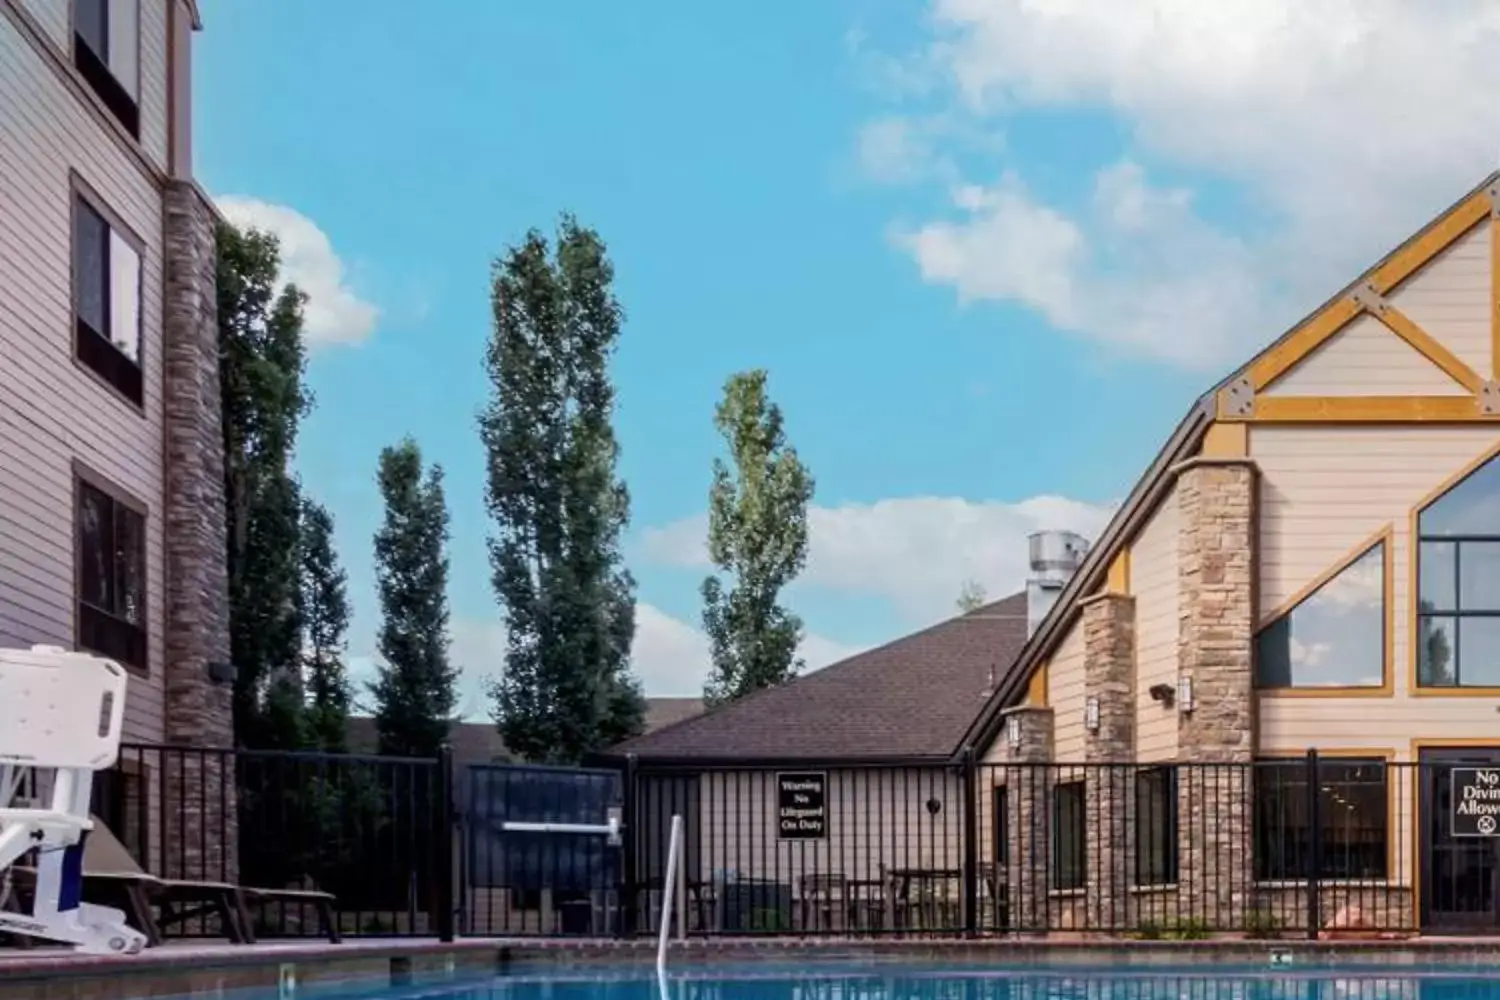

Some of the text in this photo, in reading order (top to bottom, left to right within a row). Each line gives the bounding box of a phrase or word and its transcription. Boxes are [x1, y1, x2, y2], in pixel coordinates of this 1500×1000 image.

[1475, 770, 1499, 785] No
[781, 780, 821, 793] Warning
[794, 794, 809, 804] No
[781, 820, 821, 832] On Duty
